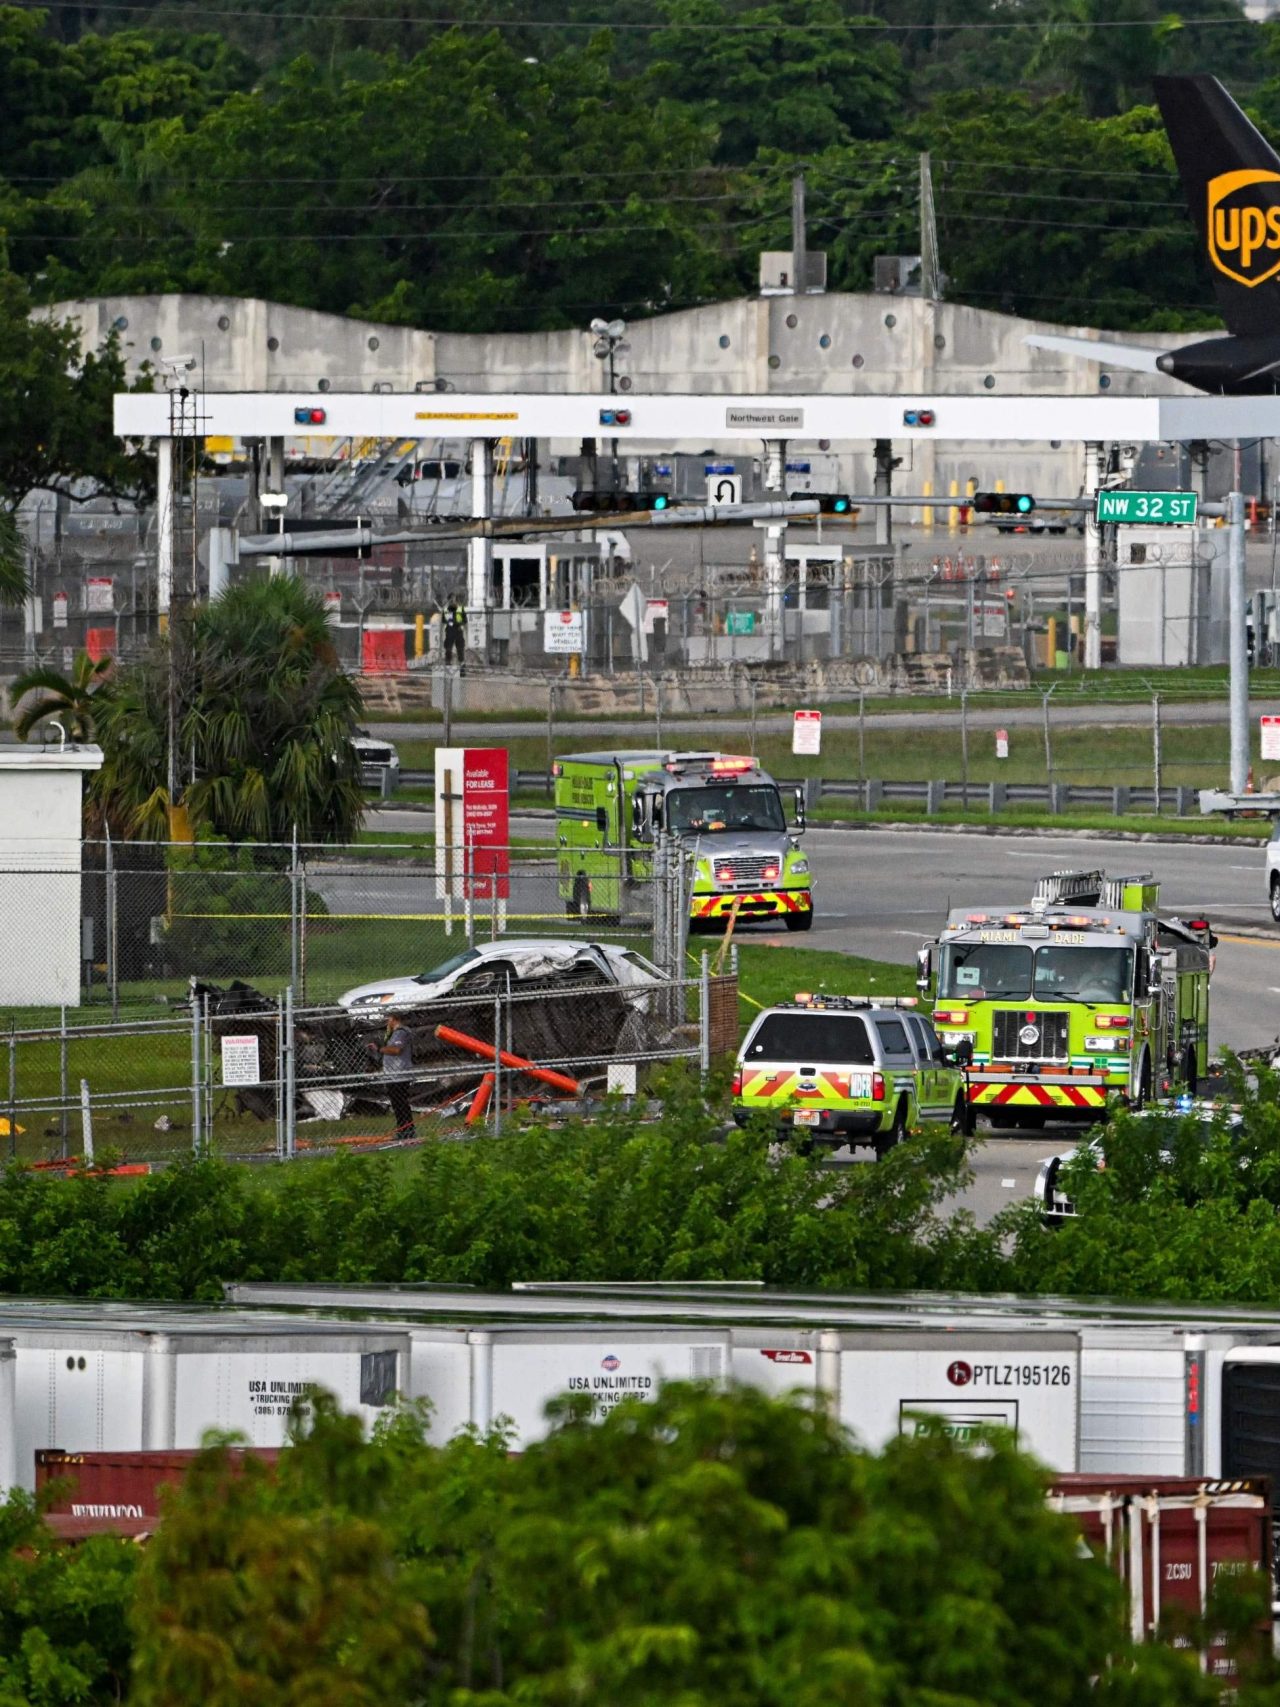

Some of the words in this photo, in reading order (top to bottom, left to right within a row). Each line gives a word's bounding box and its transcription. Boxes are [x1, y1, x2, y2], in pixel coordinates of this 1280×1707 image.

[731, 414, 775, 422] Northwest
[779, 415, 799, 423] Gate
[1103, 499, 1129, 515] NW
[1136, 498, 1164, 518] 32
[1170, 499, 1191, 516] ST
[466, 769, 489, 777] Available
[466, 780, 478, 788] FOR
[478, 780, 495, 788] LEASE
[980, 931, 1017, 943] MIAMI
[1054, 933, 1085, 944] DADE
[973, 1365, 1070, 1386] PTLZ195126
[249, 1381, 267, 1393] USA
[568, 1377, 590, 1390] USA
[593, 1376, 651, 1389] UNLIMITED
[256, 1394, 290, 1404] TRUCKING
[1166, 1563, 1192, 1580] ZCSU
